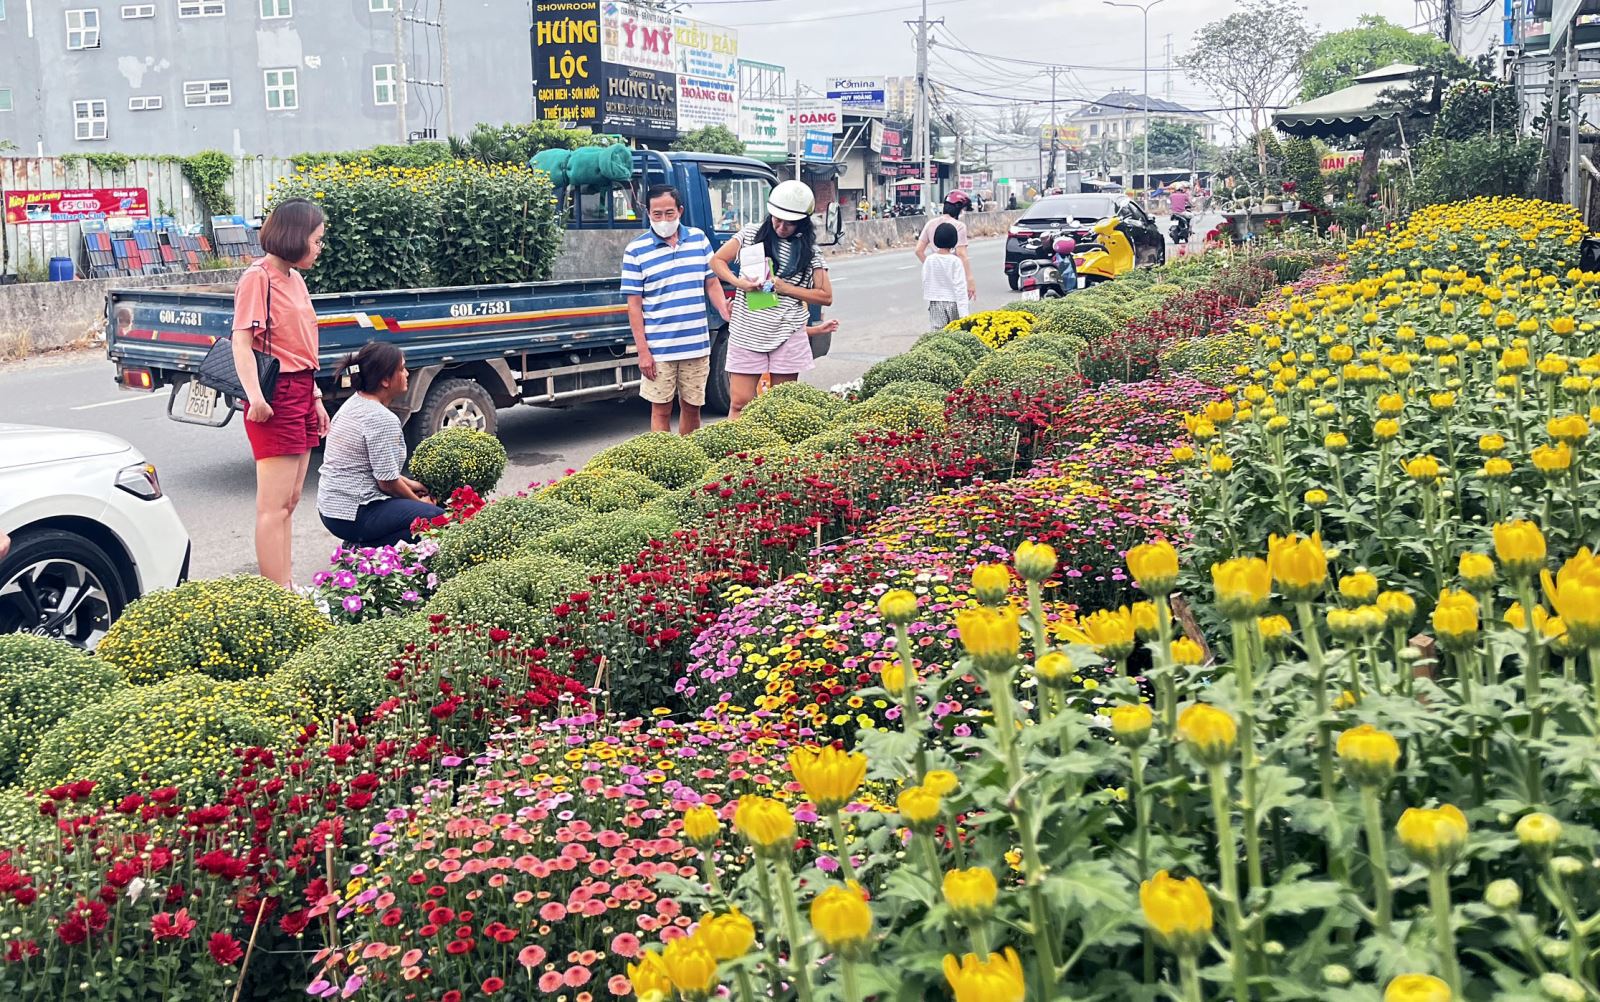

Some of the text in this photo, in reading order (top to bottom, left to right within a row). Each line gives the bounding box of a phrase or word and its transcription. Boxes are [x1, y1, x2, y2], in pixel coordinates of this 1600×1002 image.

[537, 2, 596, 12] SHOWROOM
[537, 16, 598, 46] HƯNG
[549, 49, 588, 85] LỘC
[538, 88, 554, 102] GẠCH
[584, 84, 600, 100] NƯỚC
[609, 77, 647, 99] HƯNG
[651, 81, 674, 105] LỘC
[681, 86, 734, 103] HOÀNG GIA
[543, 104, 562, 119] THIẾT
[581, 106, 596, 119] SINH
[62, 201, 98, 209] F5 Club
[88, 211, 106, 219] Club
[450, 300, 512, 317] 60L-7581
[160, 310, 203, 326] 60L-7581
[188, 398, 209, 415] 7581
